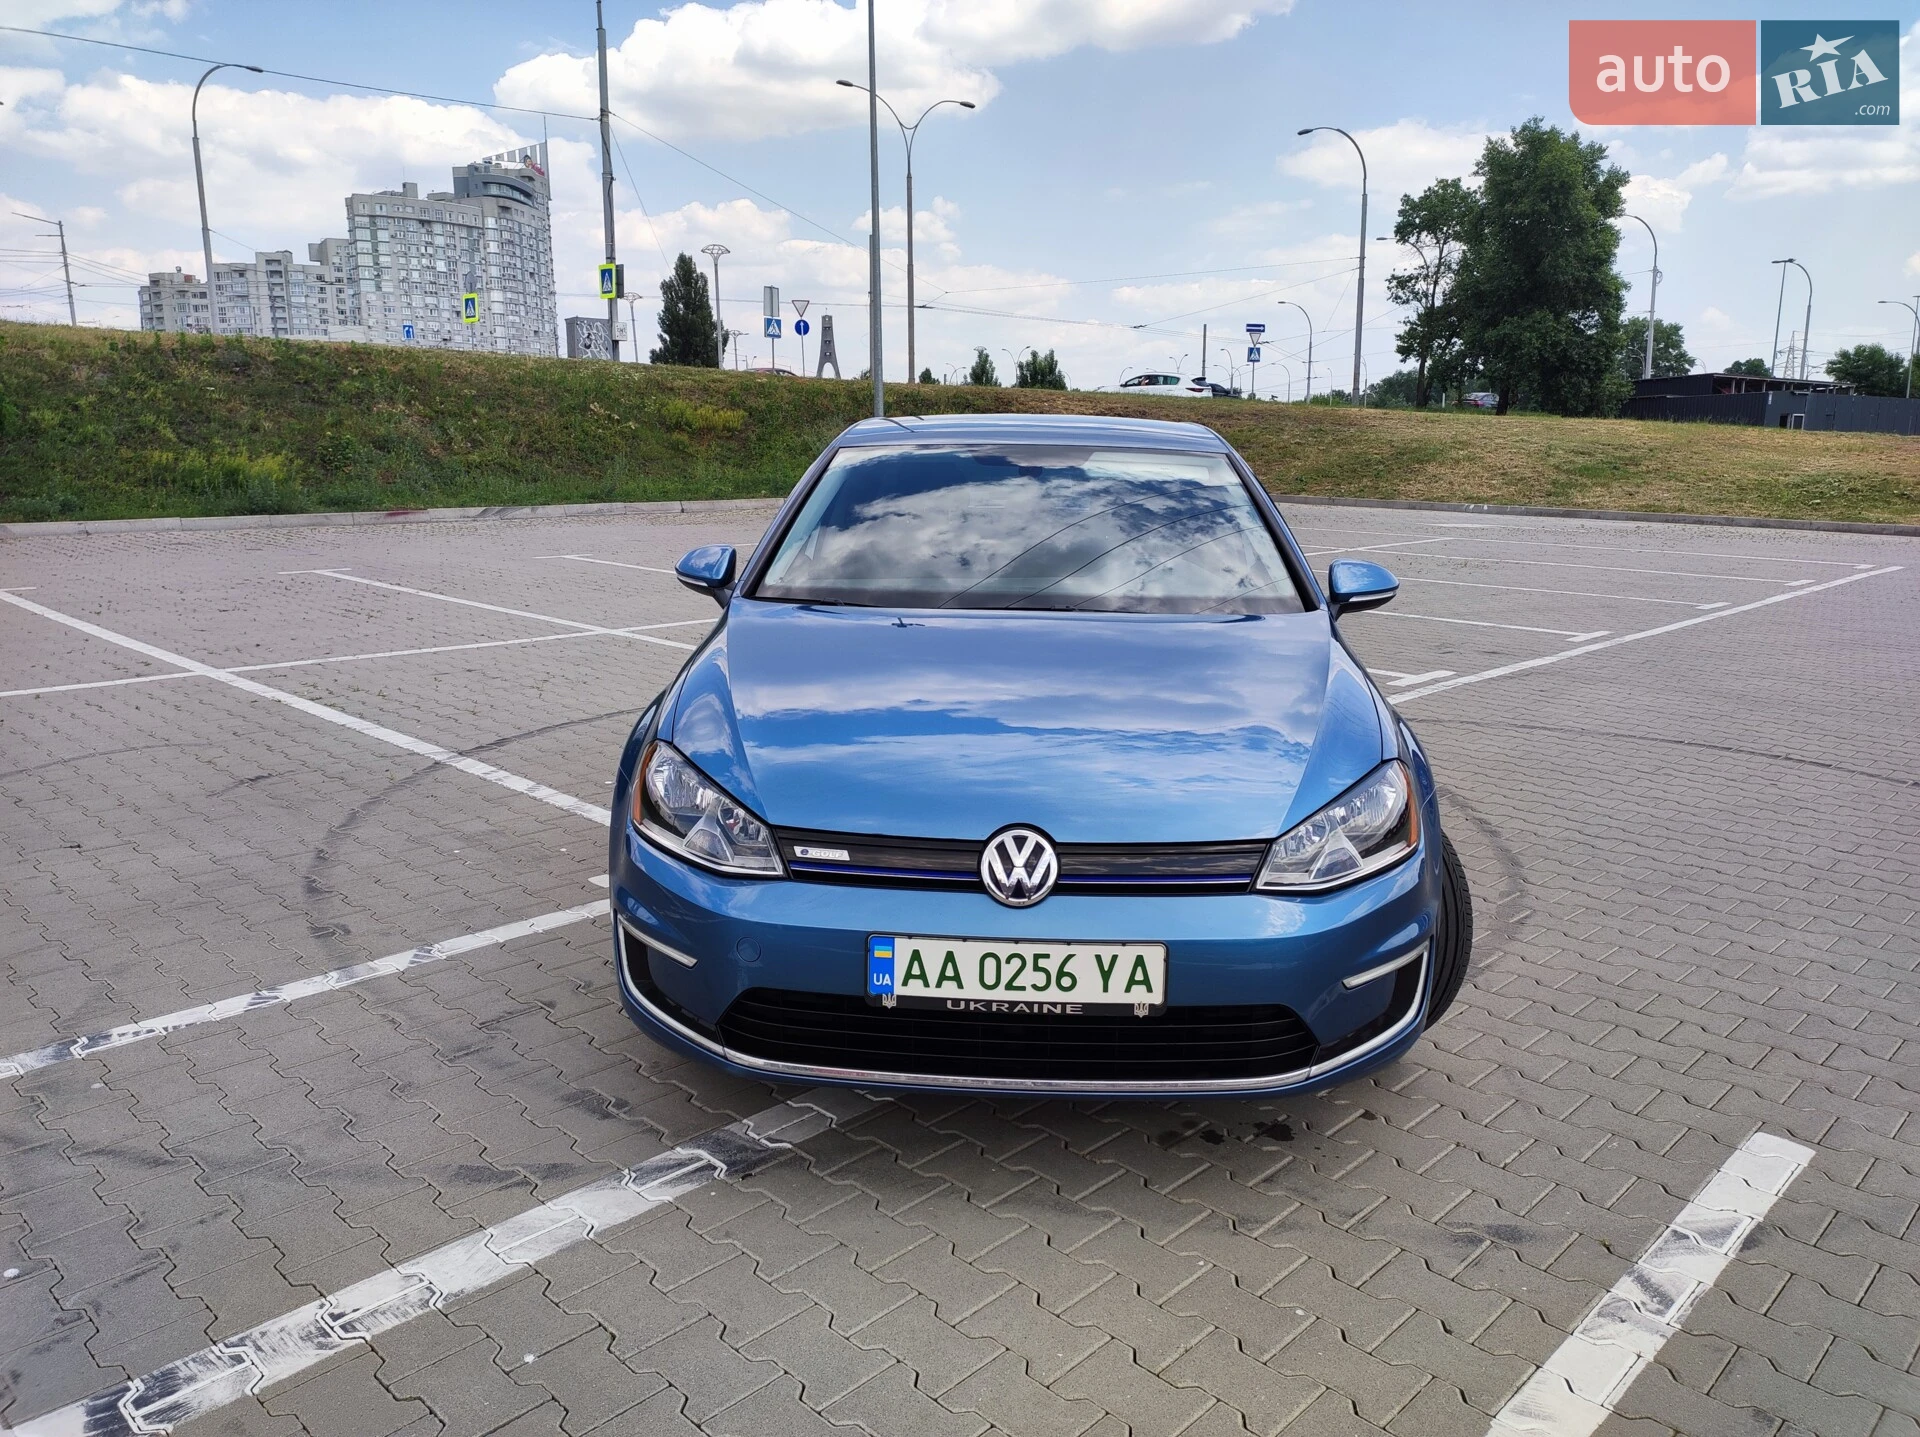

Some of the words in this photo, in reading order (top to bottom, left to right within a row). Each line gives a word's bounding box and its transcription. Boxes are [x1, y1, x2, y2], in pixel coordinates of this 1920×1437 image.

[873, 972, 892, 986] UA
[901, 949, 964, 989] AA
[978, 951, 1077, 992] 0256
[1095, 953, 1154, 993] YA
[946, 999, 1083, 1015] UKRAINE
